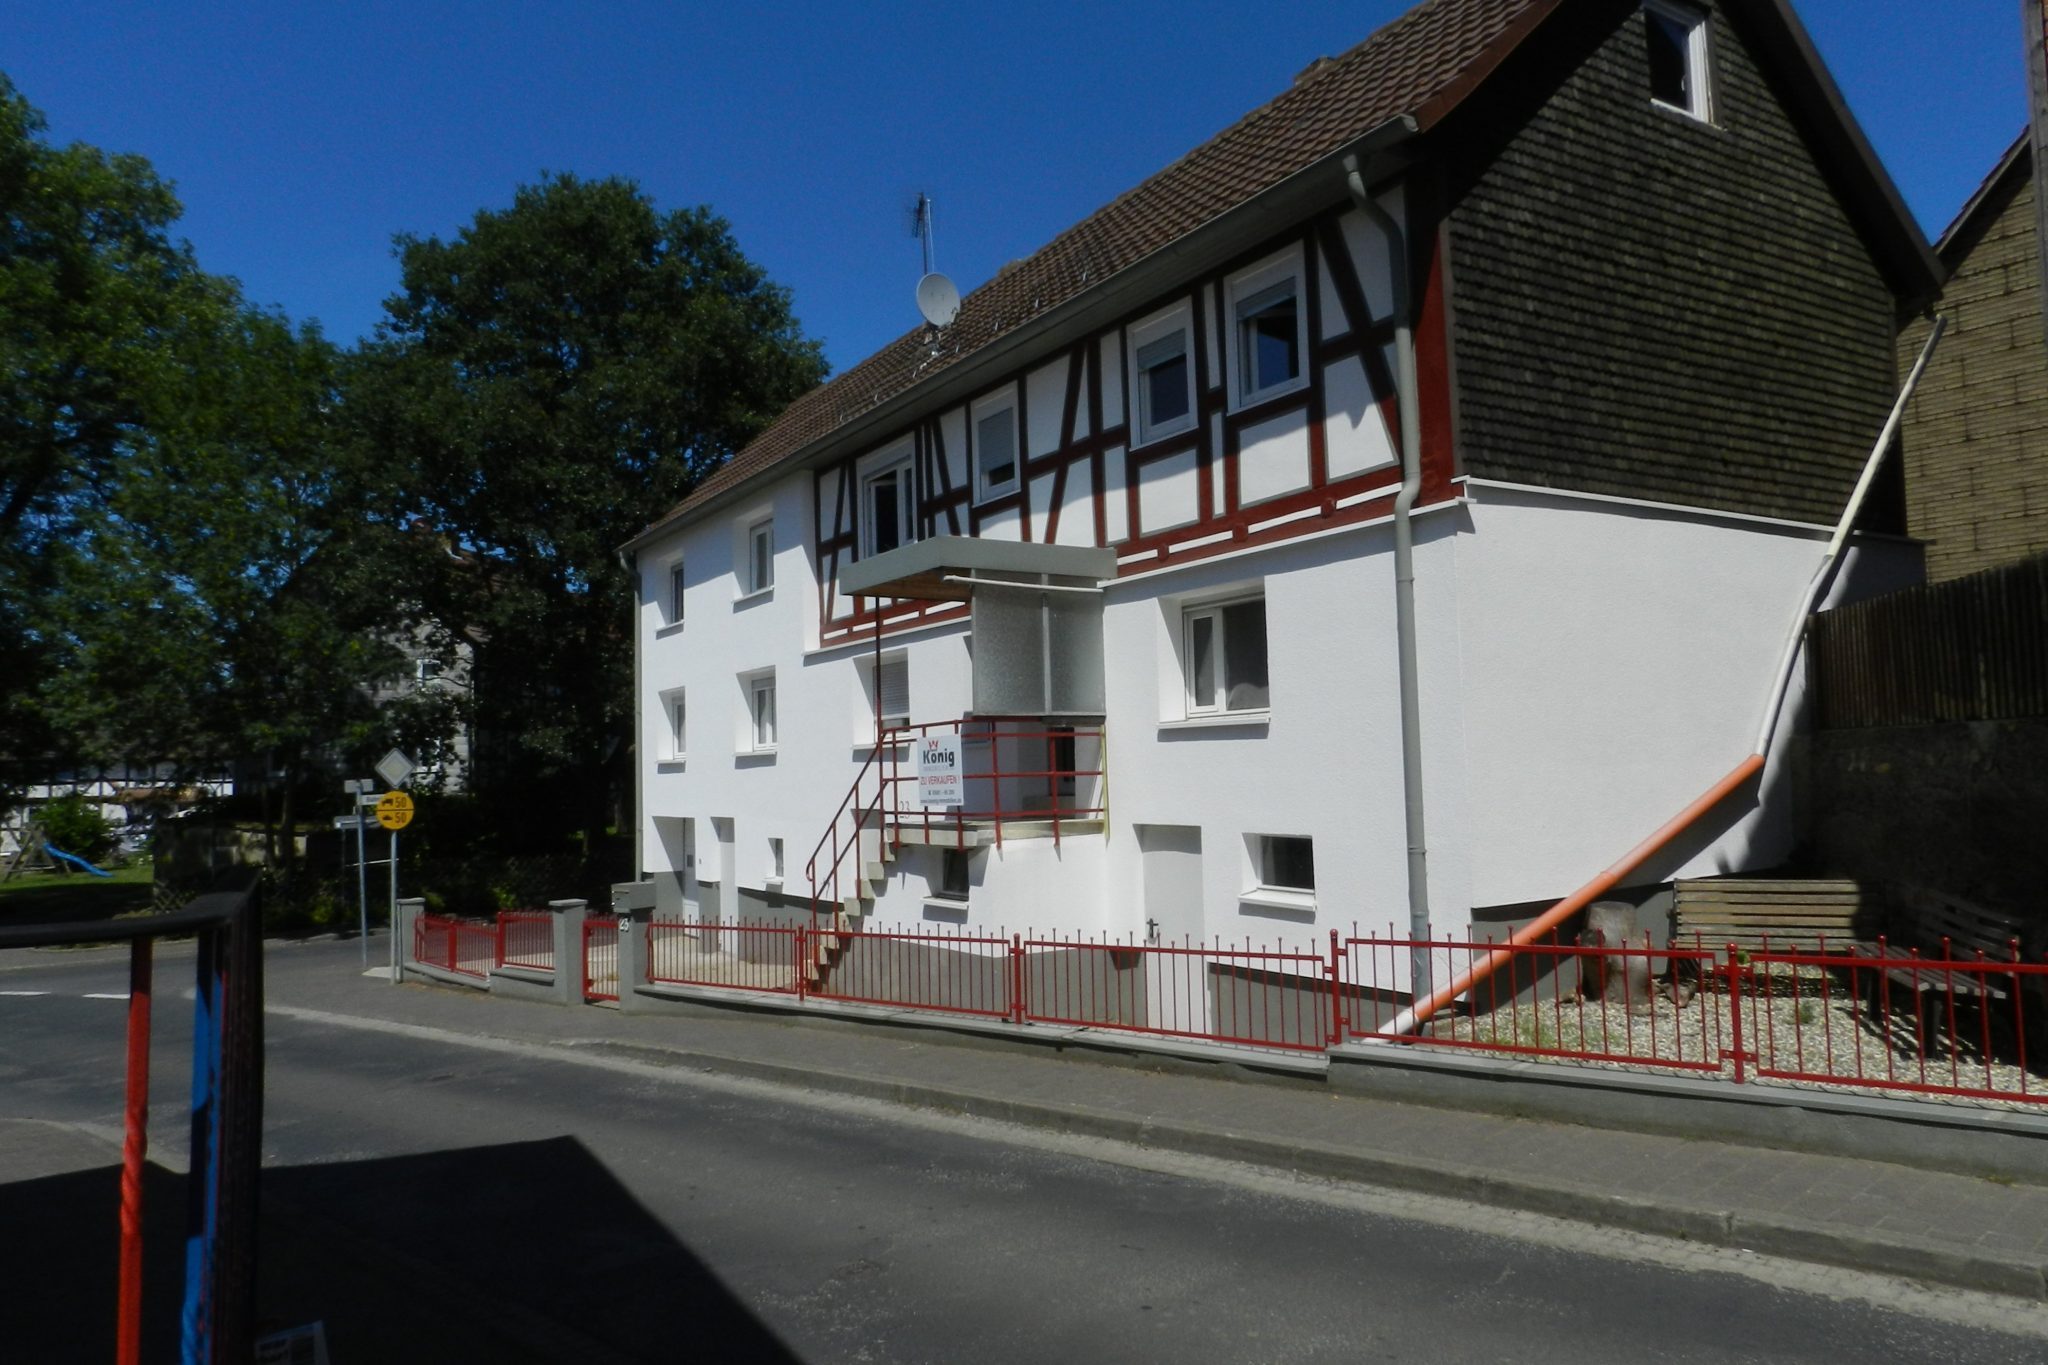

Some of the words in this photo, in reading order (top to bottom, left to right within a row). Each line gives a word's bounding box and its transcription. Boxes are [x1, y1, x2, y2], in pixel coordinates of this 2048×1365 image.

[928, 775, 957, 785] VERKAUFEN
[395, 797, 406, 808] 50
[899, 801, 910, 819] 23
[395, 812, 406, 823] 50
